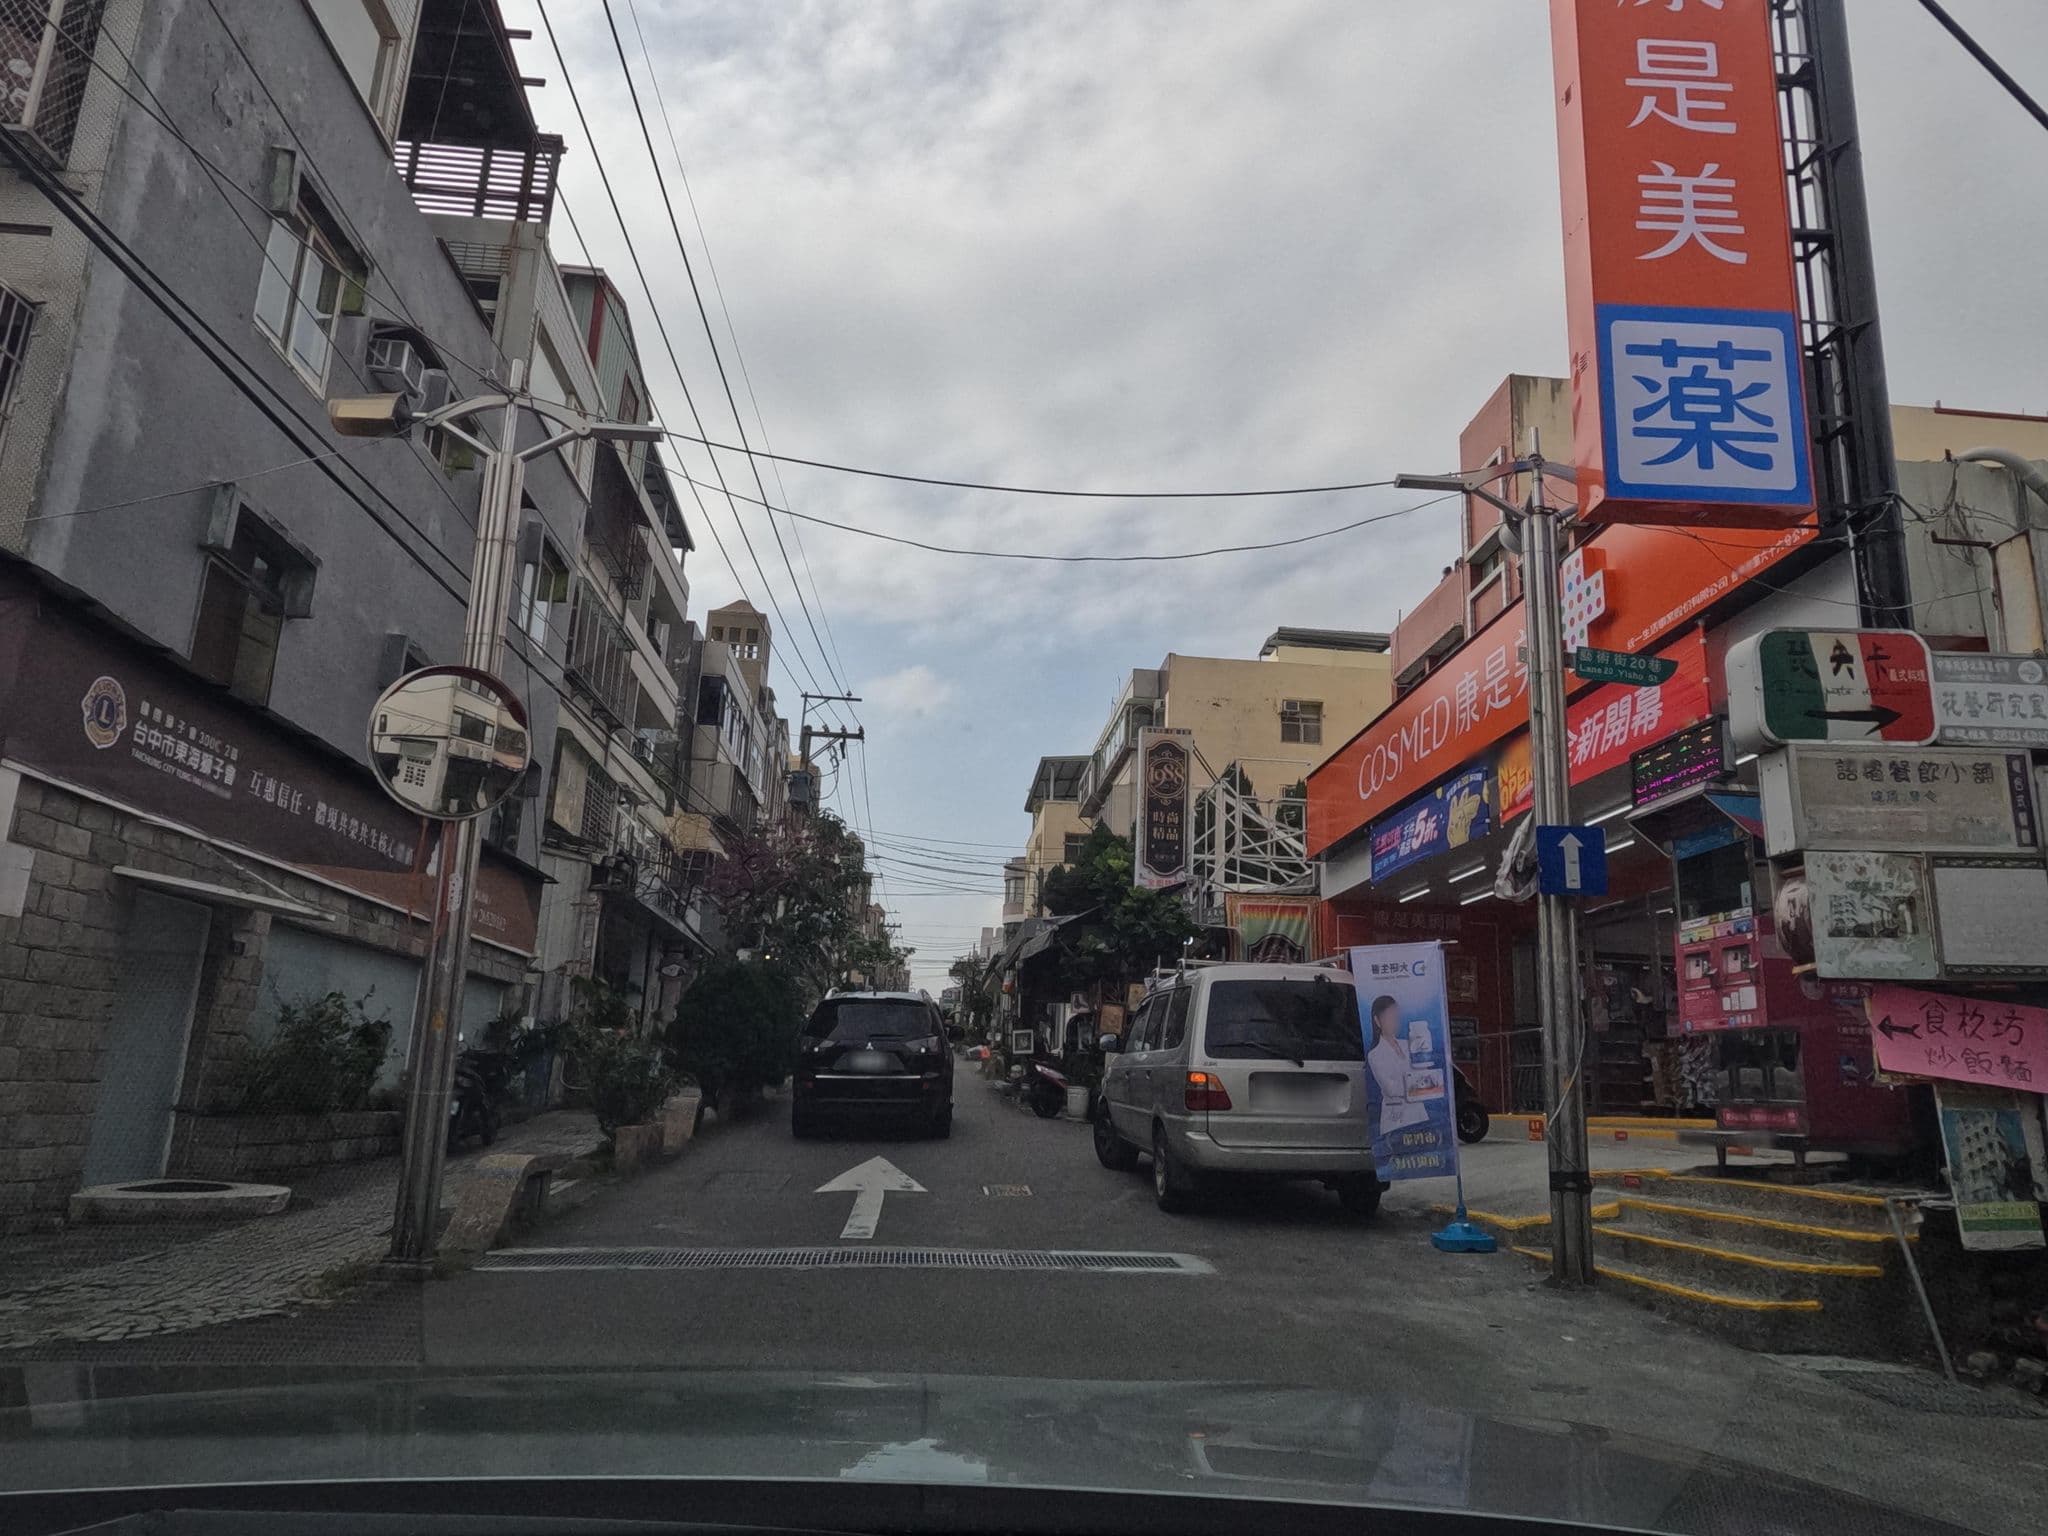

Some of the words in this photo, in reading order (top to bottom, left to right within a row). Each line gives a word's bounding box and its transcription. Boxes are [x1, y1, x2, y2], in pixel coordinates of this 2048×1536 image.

[1616, 0, 1748, 266] 是美
[1579, 664, 1602, 674] Lane
[133, 720, 236, 786] 台中市東海獅子會
[1150, 763, 1184, 789] 1988
[1358, 695, 1450, 800] COSMED
